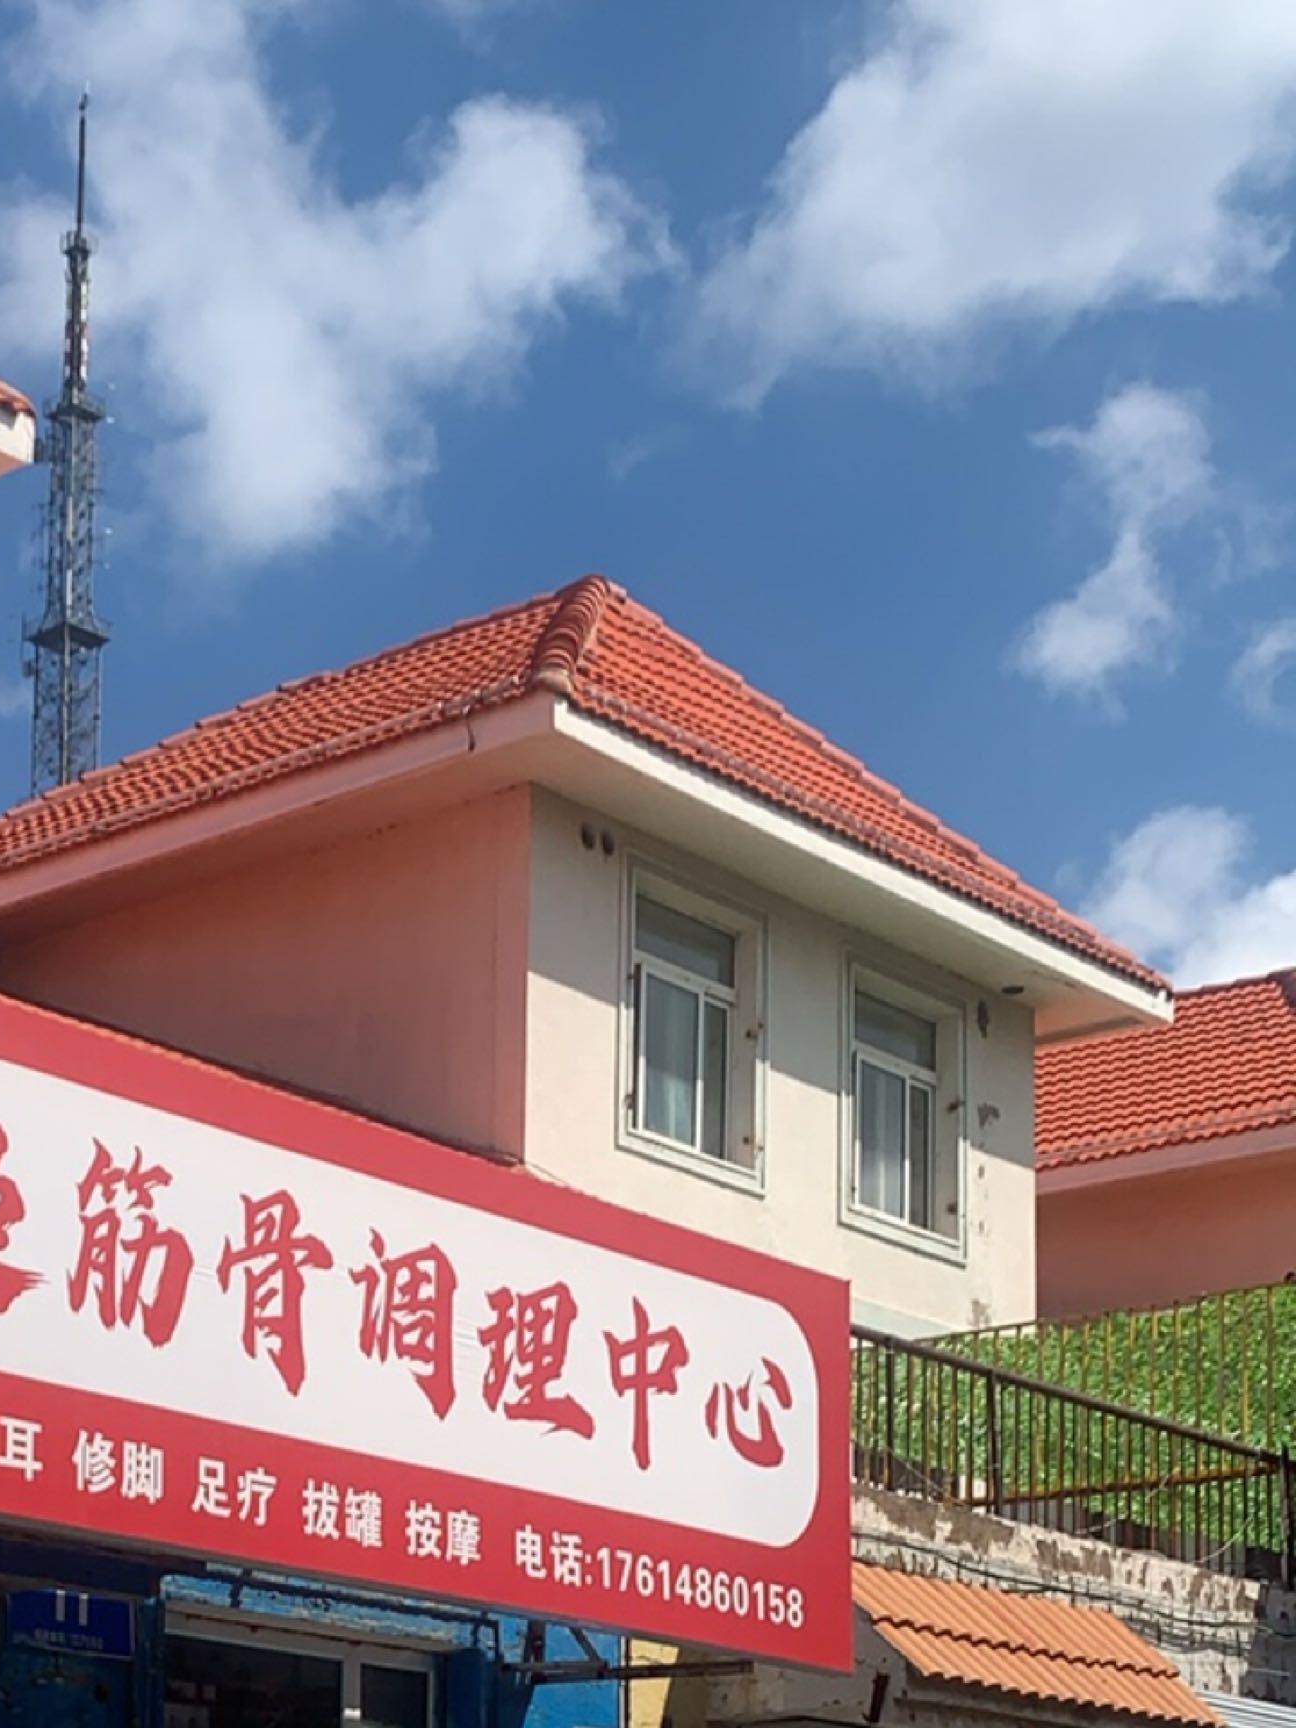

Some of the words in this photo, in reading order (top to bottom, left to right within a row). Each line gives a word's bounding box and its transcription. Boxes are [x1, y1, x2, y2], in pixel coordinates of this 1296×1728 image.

[71, 1430, 165, 1504] 修脚
[191, 1457, 277, 1526] 足疗
[302, 1479, 382, 1548] 拔罐
[405, 1500, 481, 1566] 按摩
